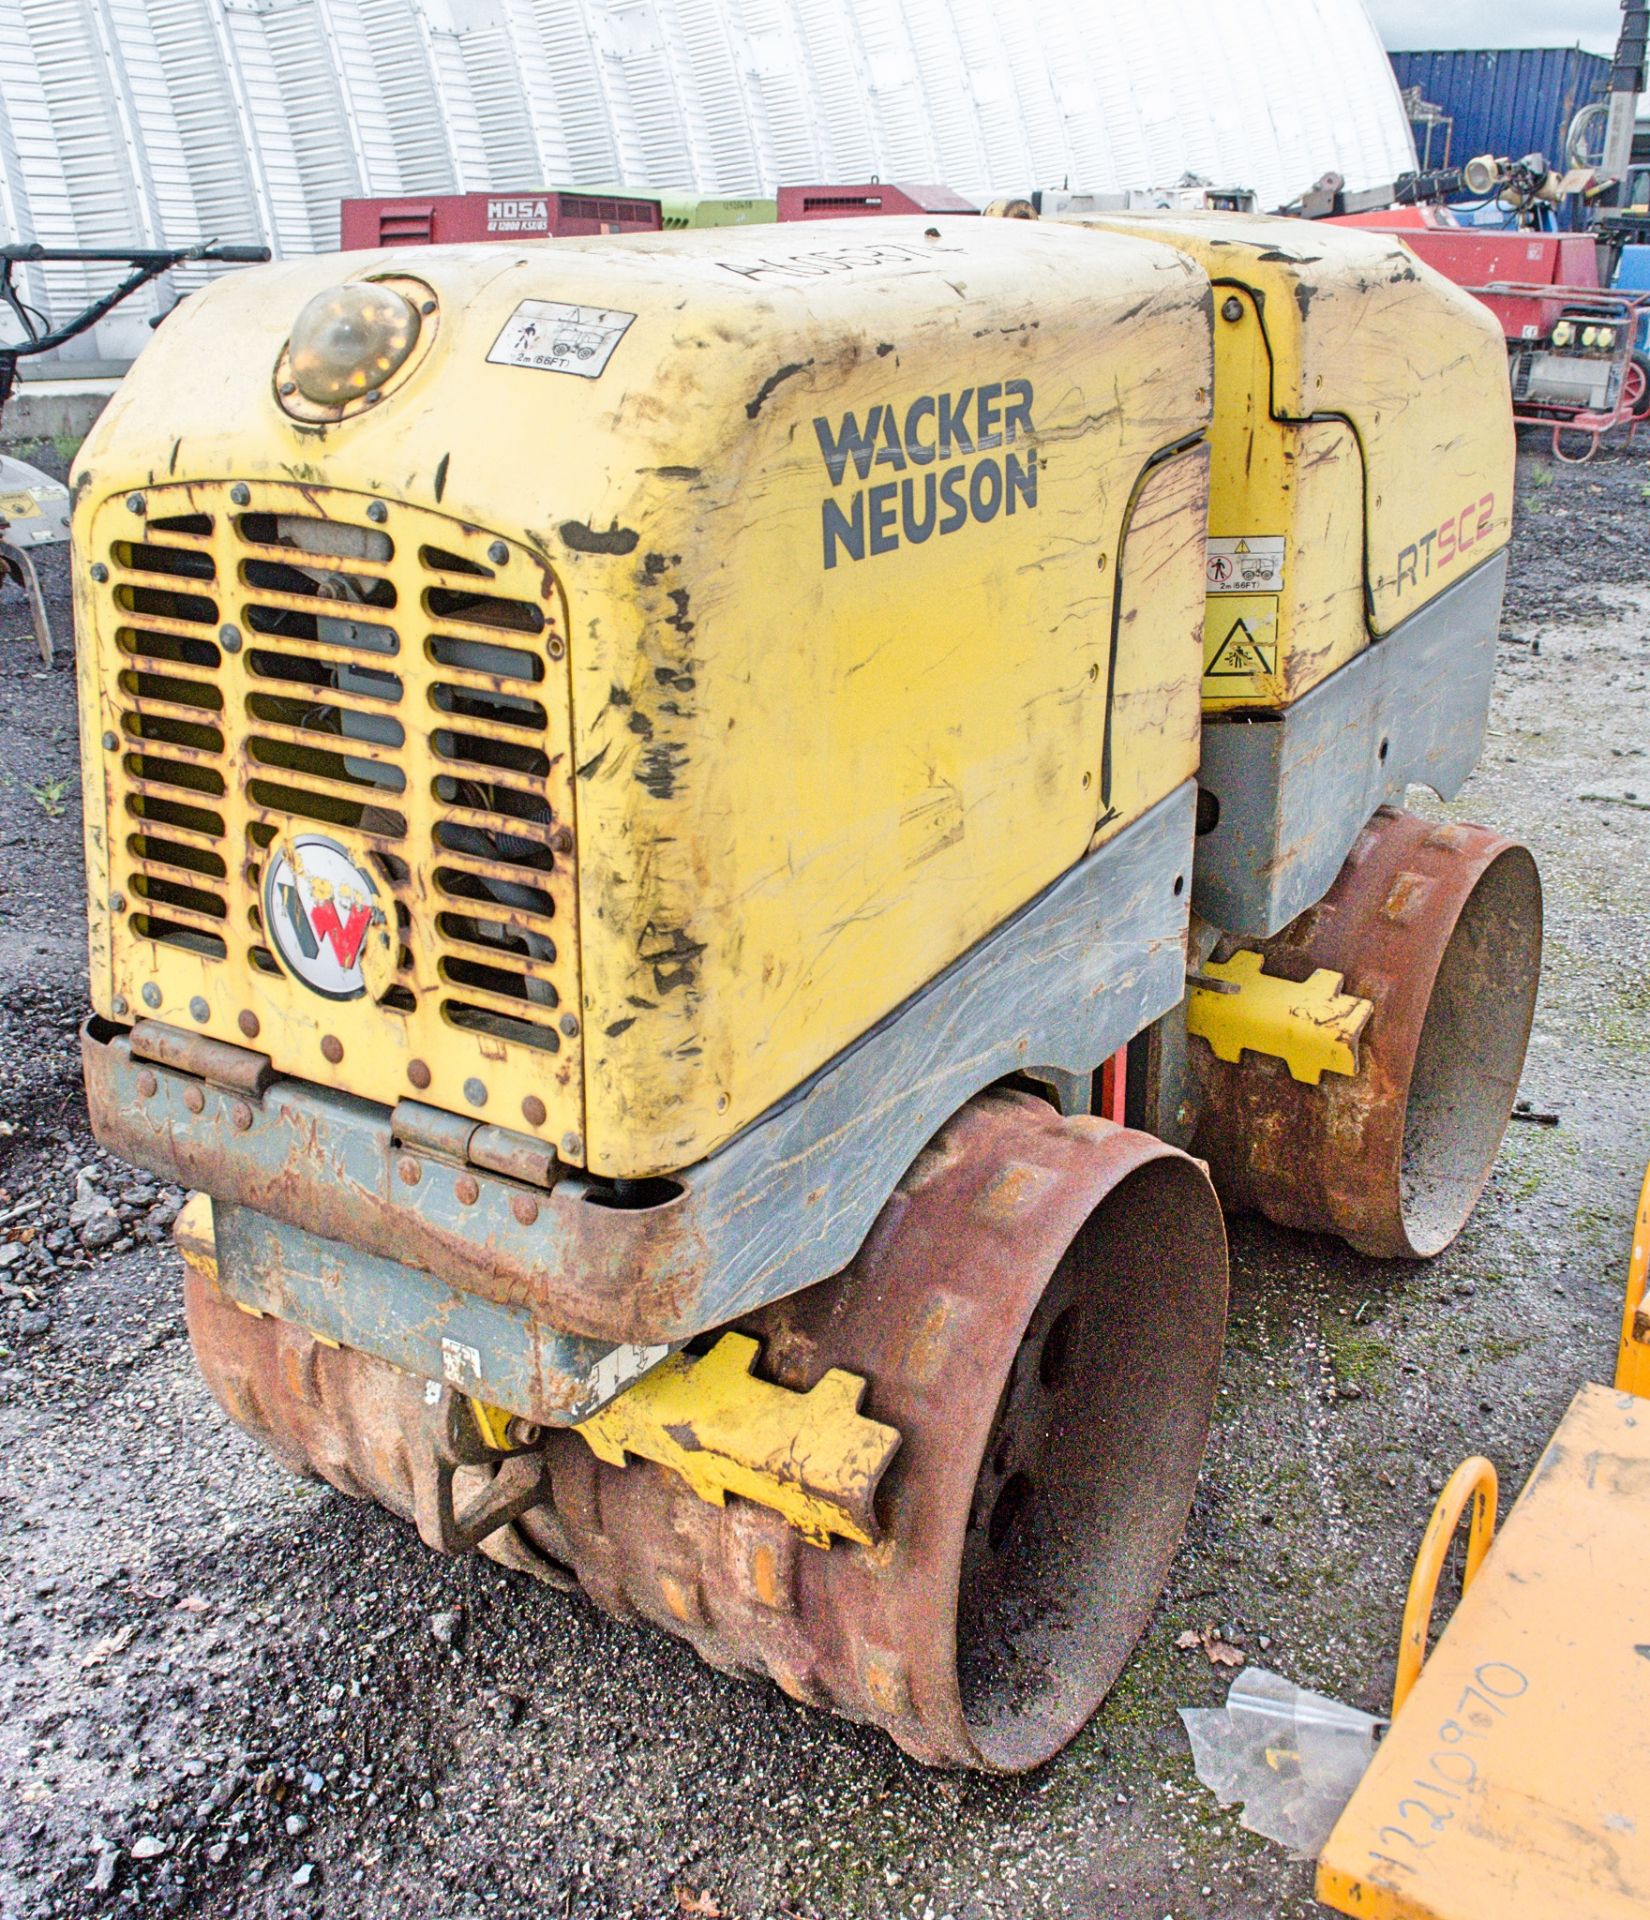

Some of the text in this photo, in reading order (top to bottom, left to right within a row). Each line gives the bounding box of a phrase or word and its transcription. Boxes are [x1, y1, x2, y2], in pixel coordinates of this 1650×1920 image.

[487, 201, 548, 219] MOSA
[812, 378, 1036, 487] WACKER
[821, 449, 1038, 570] NEUSON
